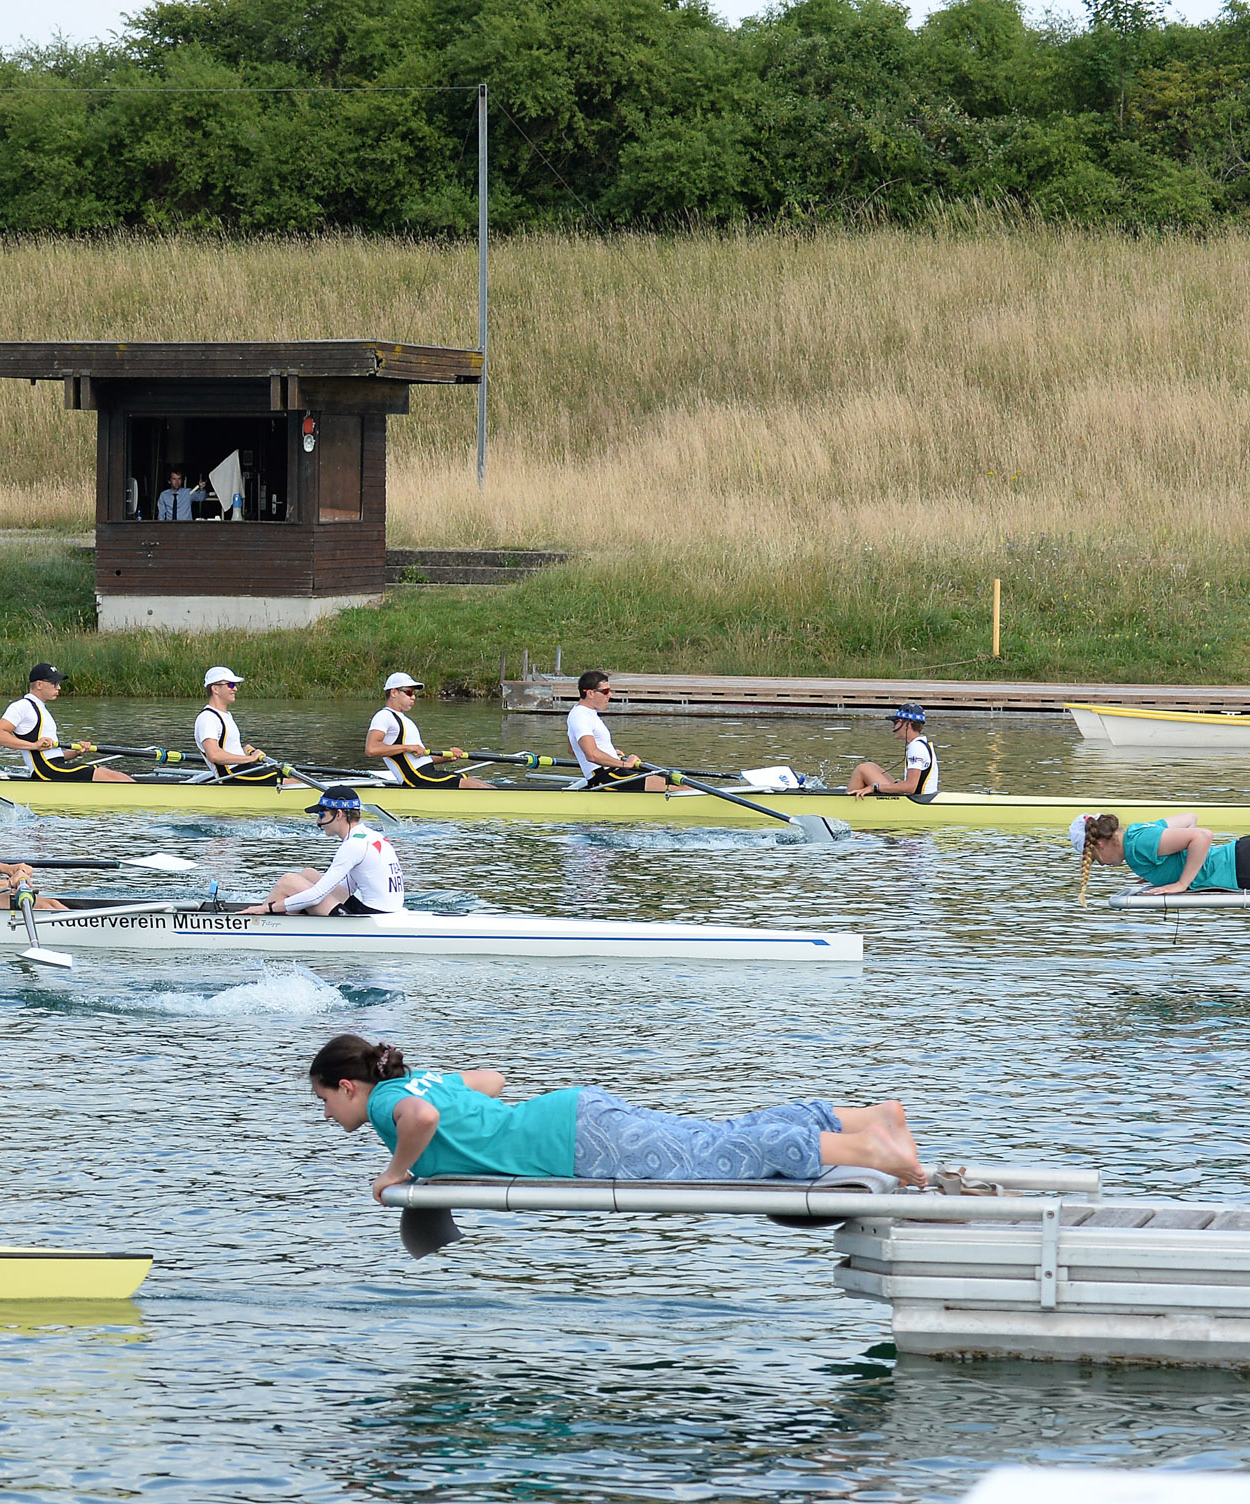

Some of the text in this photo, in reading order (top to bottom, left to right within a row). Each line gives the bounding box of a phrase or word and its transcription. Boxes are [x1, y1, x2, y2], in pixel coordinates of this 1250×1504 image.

[388, 863, 402, 874] TEA
[389, 875, 403, 893] NR
[173, 914, 251, 929] Münster
